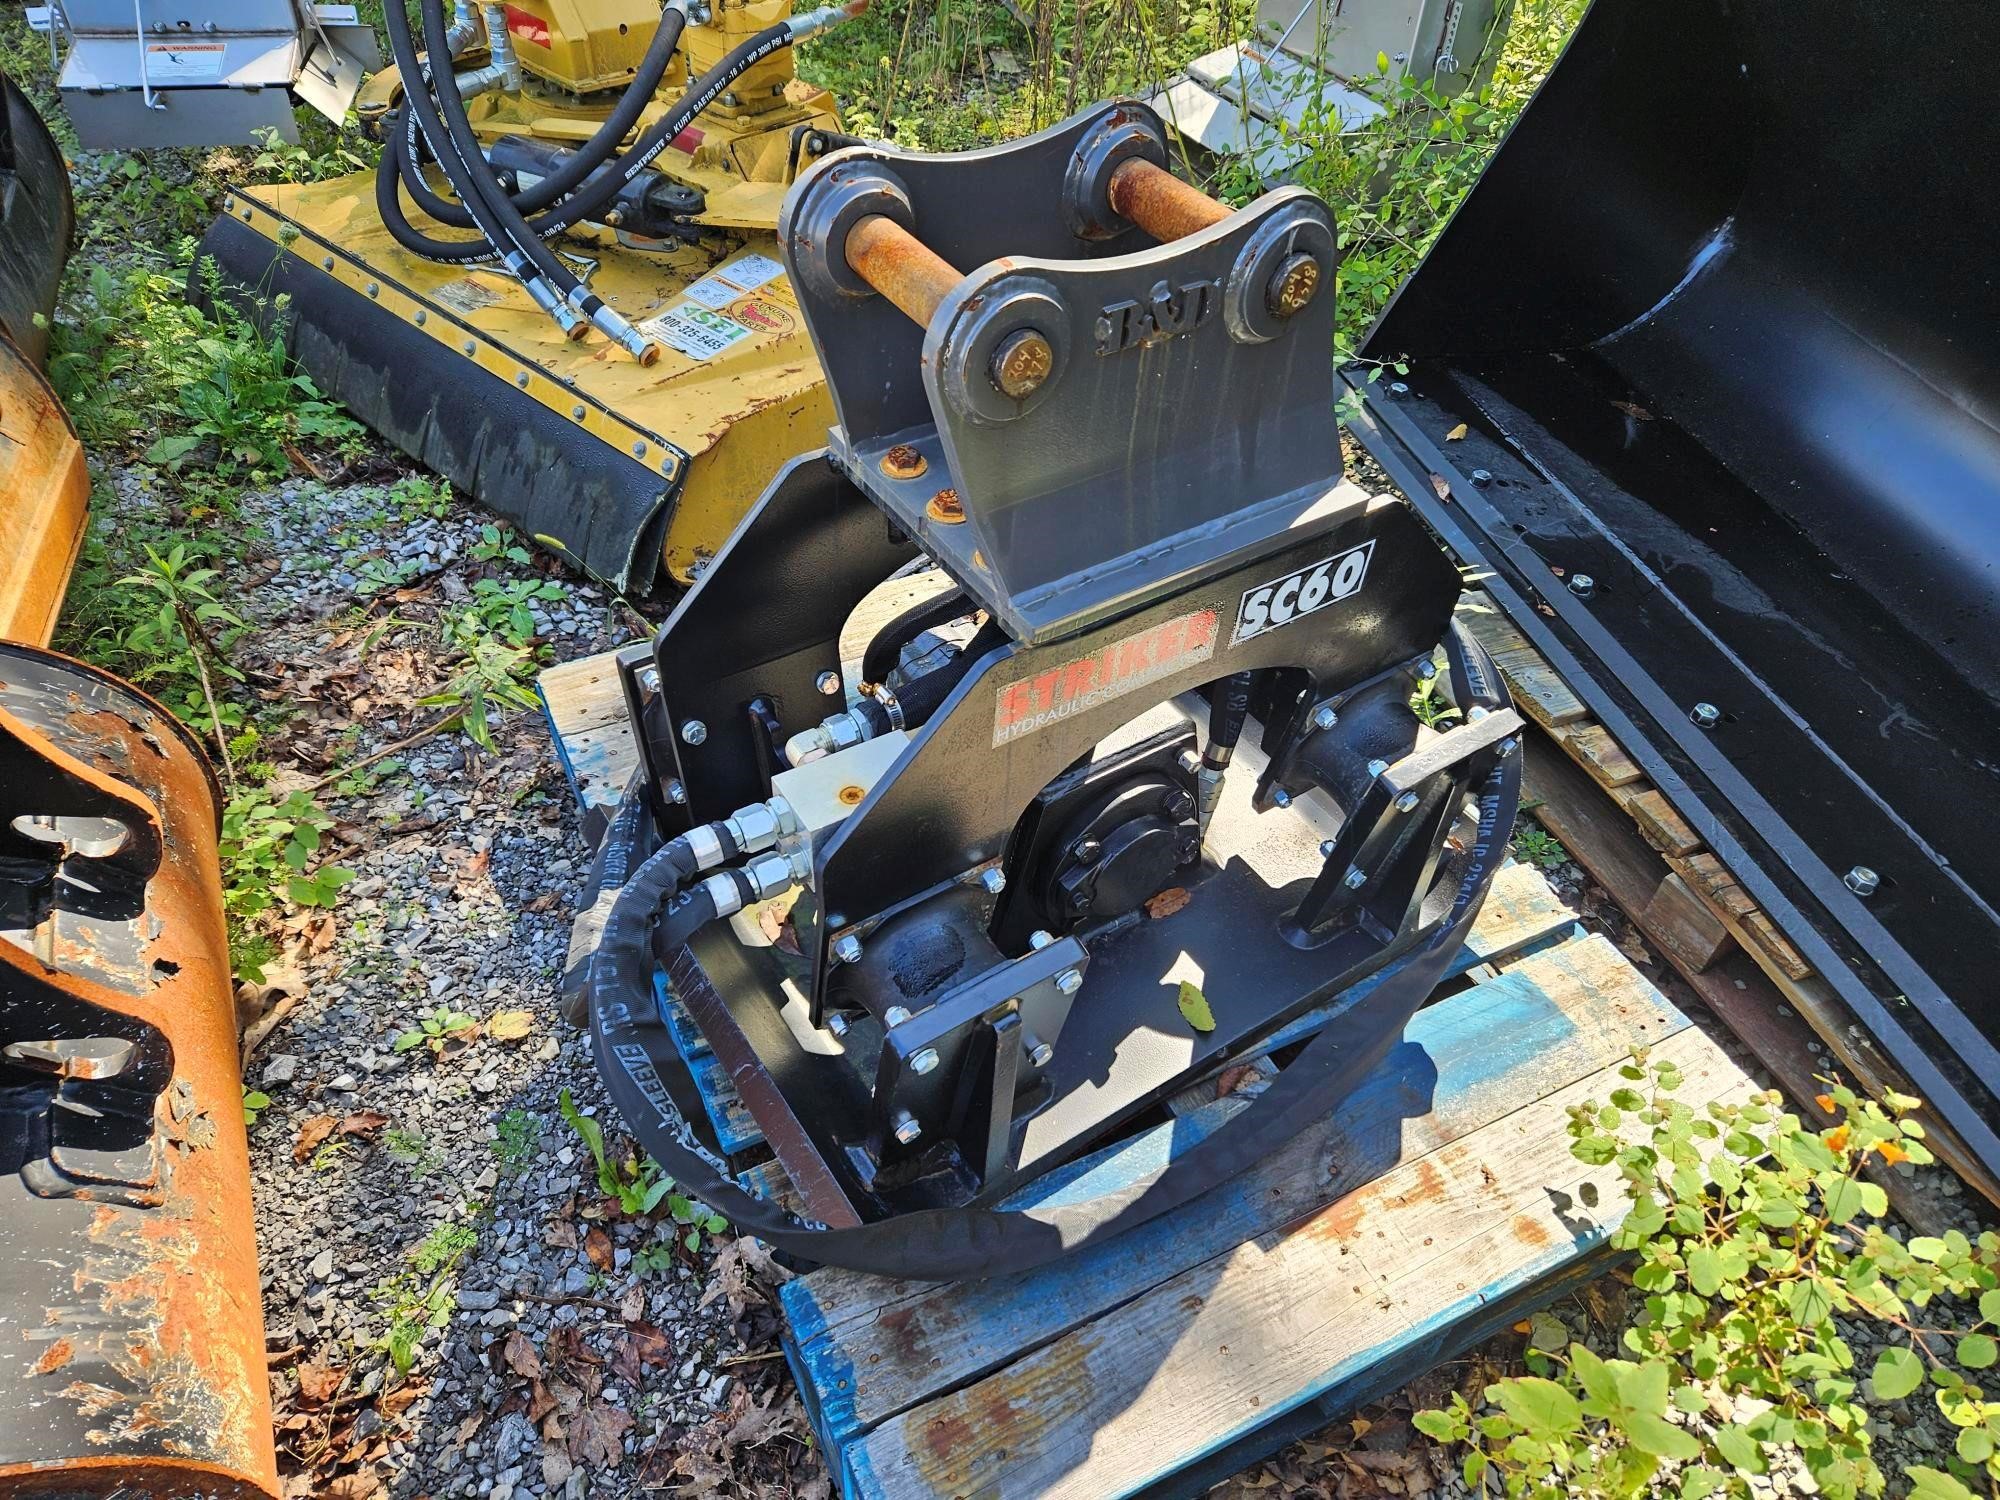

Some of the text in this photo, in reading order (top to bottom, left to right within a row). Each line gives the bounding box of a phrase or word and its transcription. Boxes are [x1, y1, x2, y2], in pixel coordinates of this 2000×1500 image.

[673, 112, 692, 134] KURT
[757, 42, 772, 58] 3000
[659, 315, 725, 350] 800-325-6455
[736, 313, 768, 332] PARTS
[1236, 549, 1366, 640] SC60
[999, 606, 1218, 729] STRIKER
[996, 684, 1102, 744] HYDRAULIC
[1477, 794, 1500, 838] MSHA
[616, 1045, 677, 1116] SLEEVE
